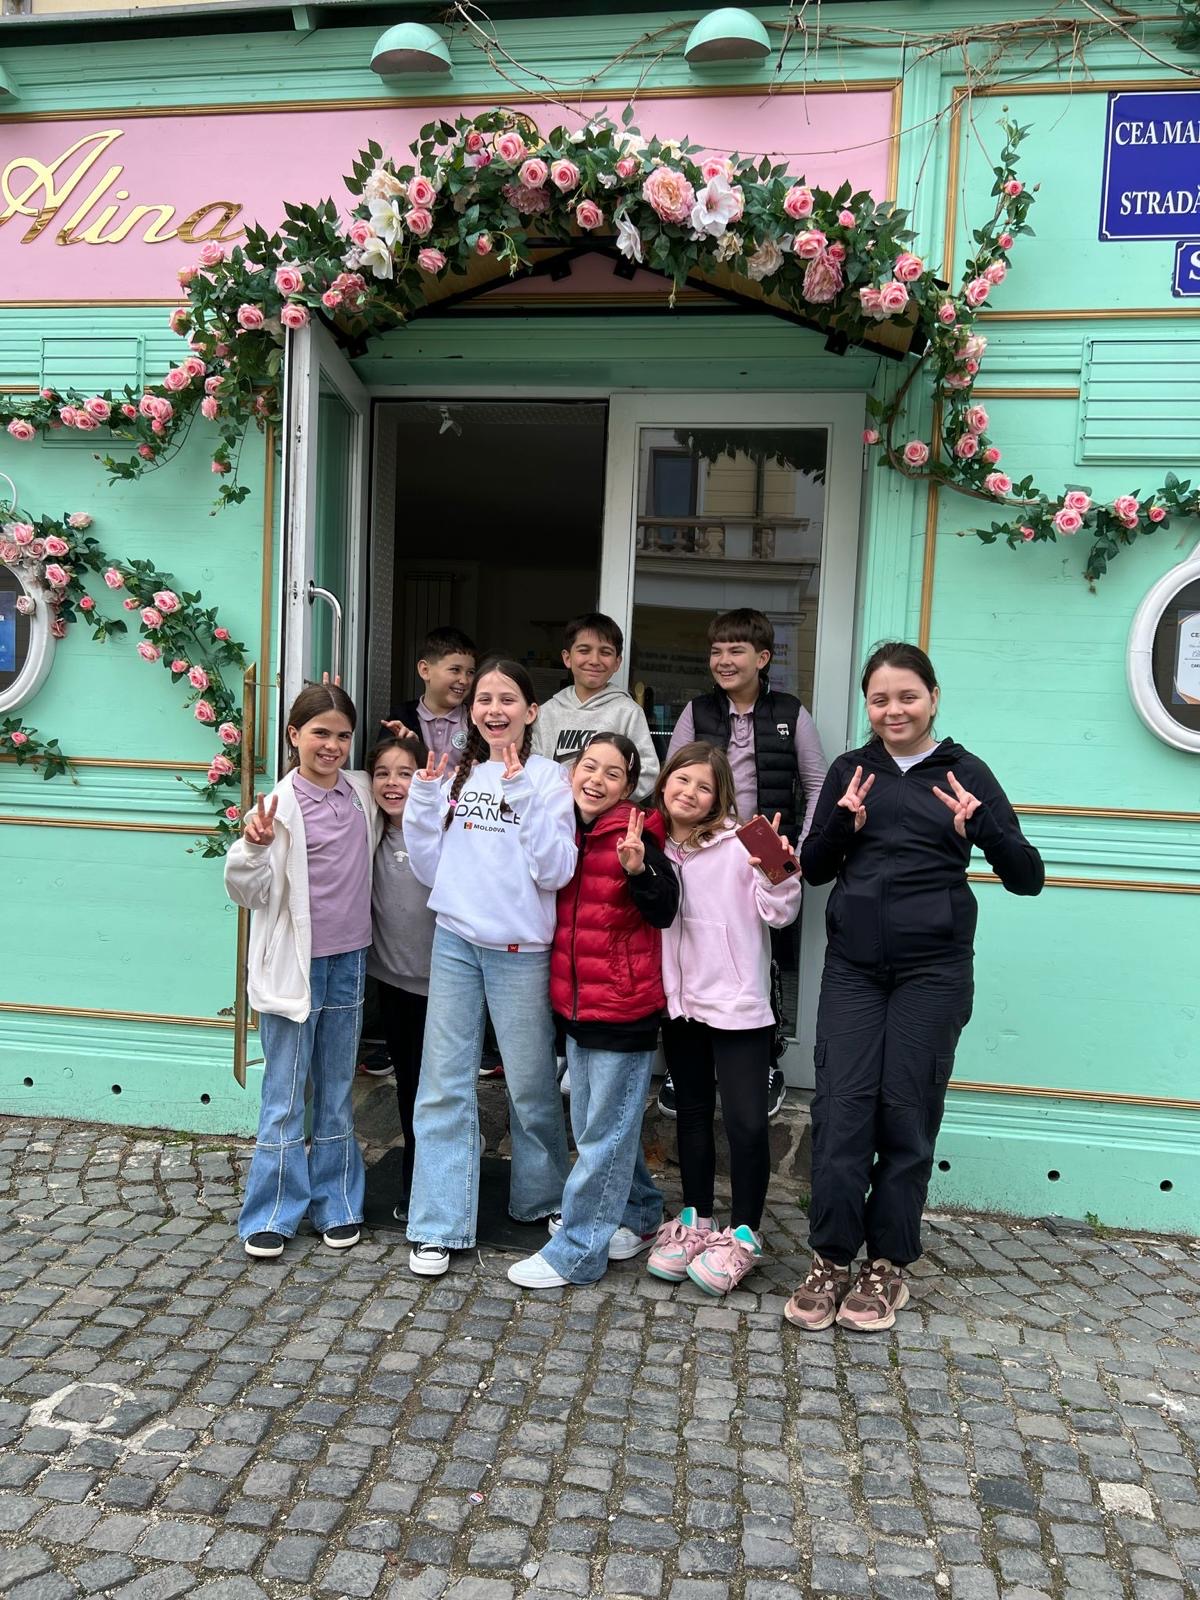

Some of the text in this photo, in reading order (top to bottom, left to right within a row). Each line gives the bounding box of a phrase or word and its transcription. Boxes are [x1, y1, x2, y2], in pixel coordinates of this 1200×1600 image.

[1115, 120, 1200, 146] CEA MA
[0, 129, 247, 245] Alina
[447, 791, 499, 806] ORL
[455, 804, 521, 826] DANCE
[473, 823, 506, 834] MOLDOVA
